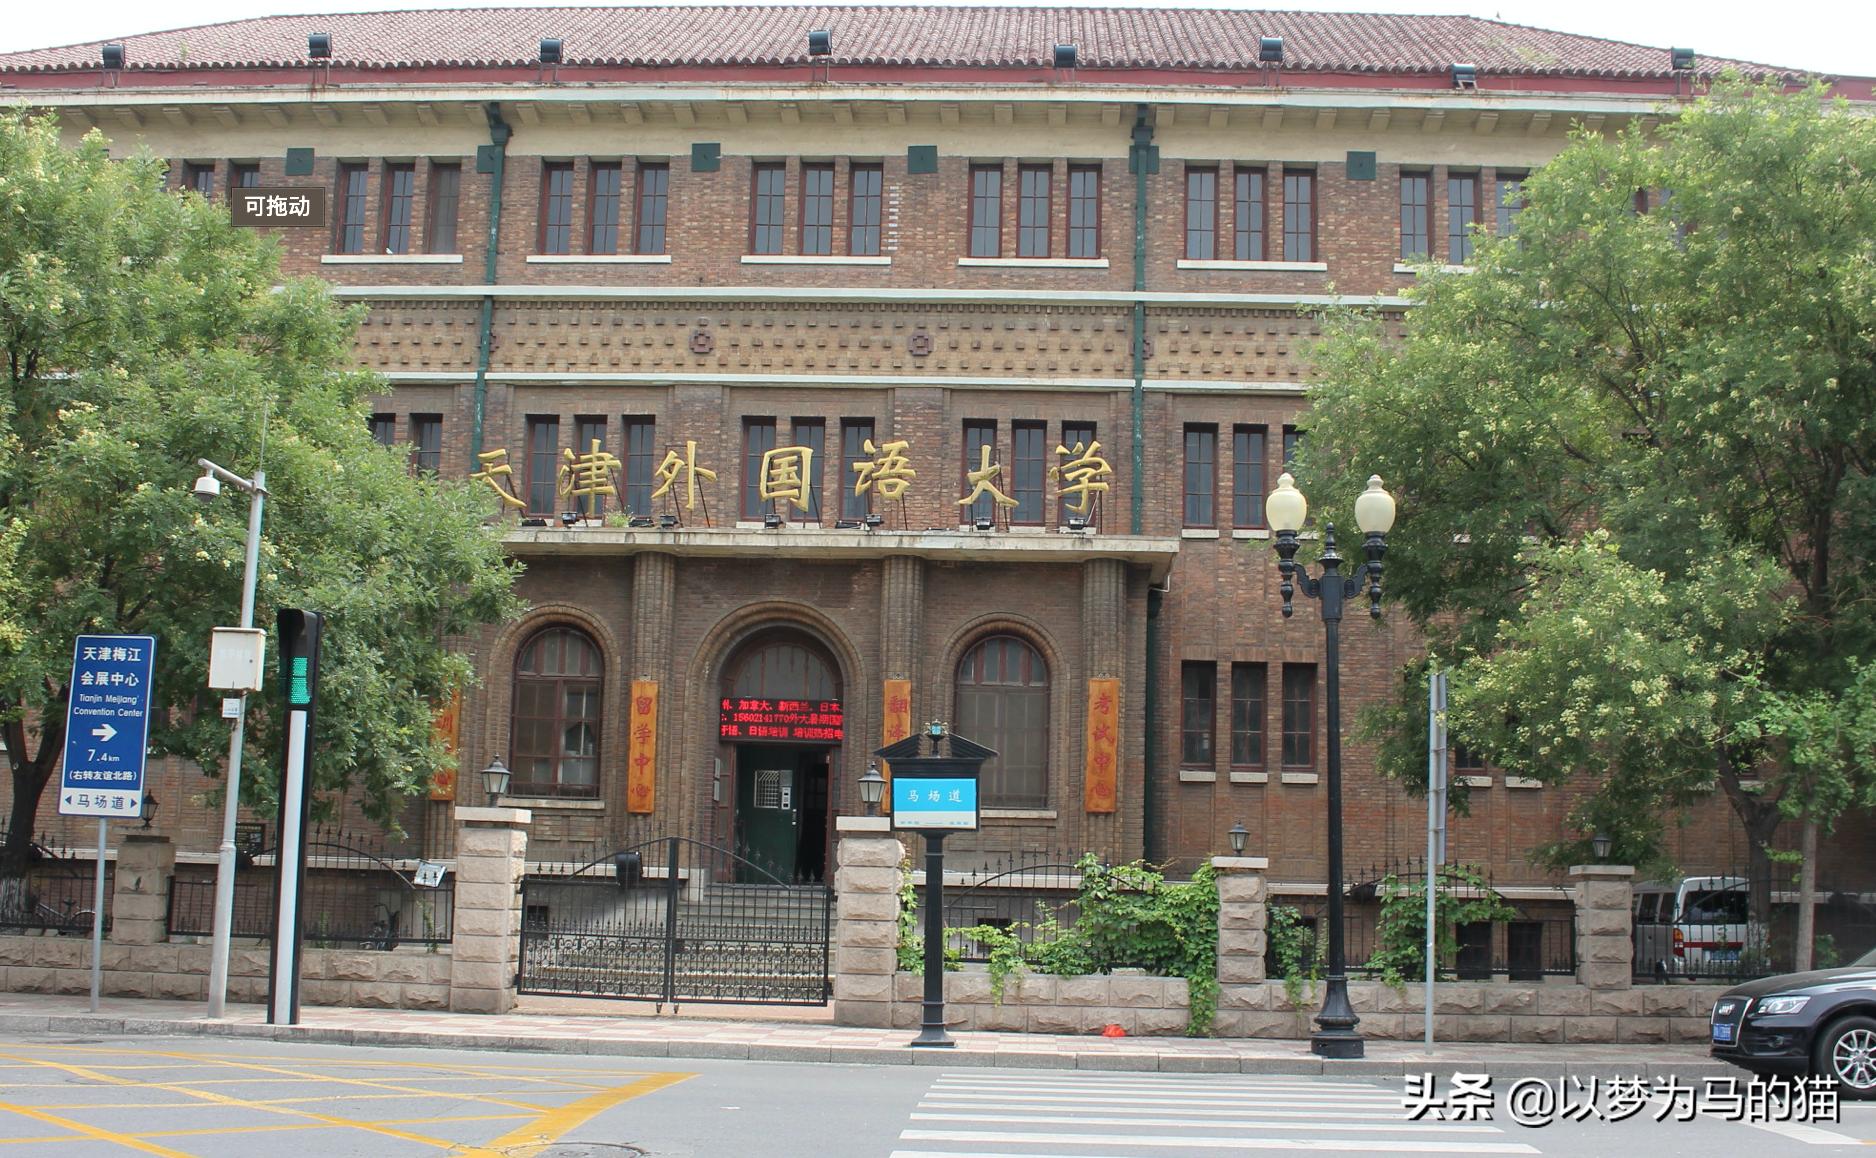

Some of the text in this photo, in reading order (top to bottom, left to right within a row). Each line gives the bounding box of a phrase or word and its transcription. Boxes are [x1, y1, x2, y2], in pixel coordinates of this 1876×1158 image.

[469, 439, 1112, 517] 天津外国语大学
[83, 646, 141, 661] 天津梅江
[80, 671, 139, 687] 会展中心
[80, 693, 138, 706] Tianjin Meijiang
[73, 706, 143, 718] Convention Center
[77, 794, 124, 809] 马场道
[907, 788, 962, 803] 马场道
